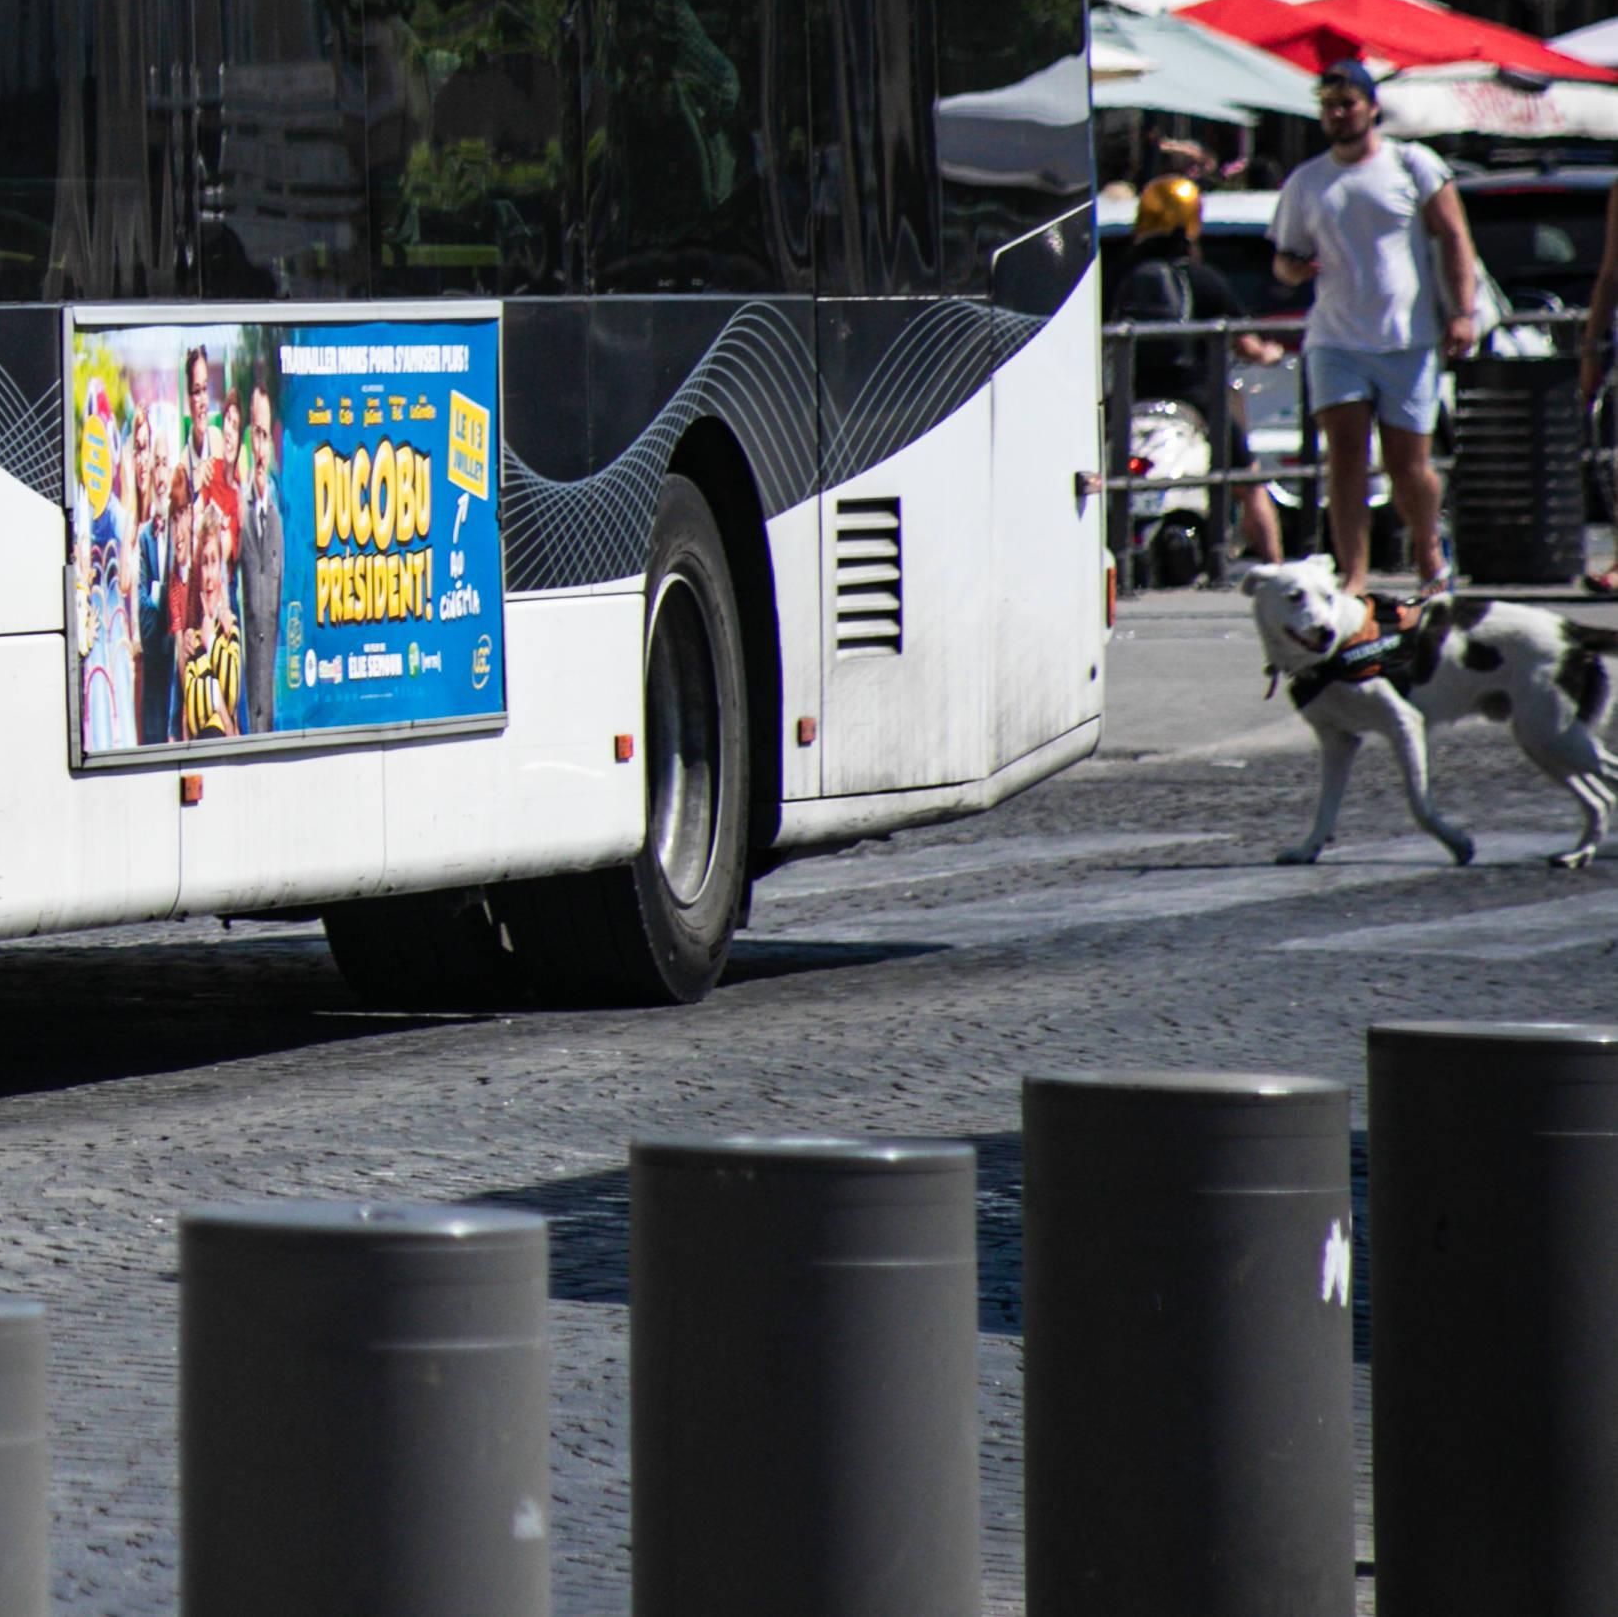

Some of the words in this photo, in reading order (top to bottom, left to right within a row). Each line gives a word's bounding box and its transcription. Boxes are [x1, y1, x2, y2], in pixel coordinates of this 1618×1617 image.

[369, 345, 394, 373] POUR
[455, 408, 466, 441] LE
[469, 418, 483, 451] 13
[314, 436, 432, 553] DUCOBU
